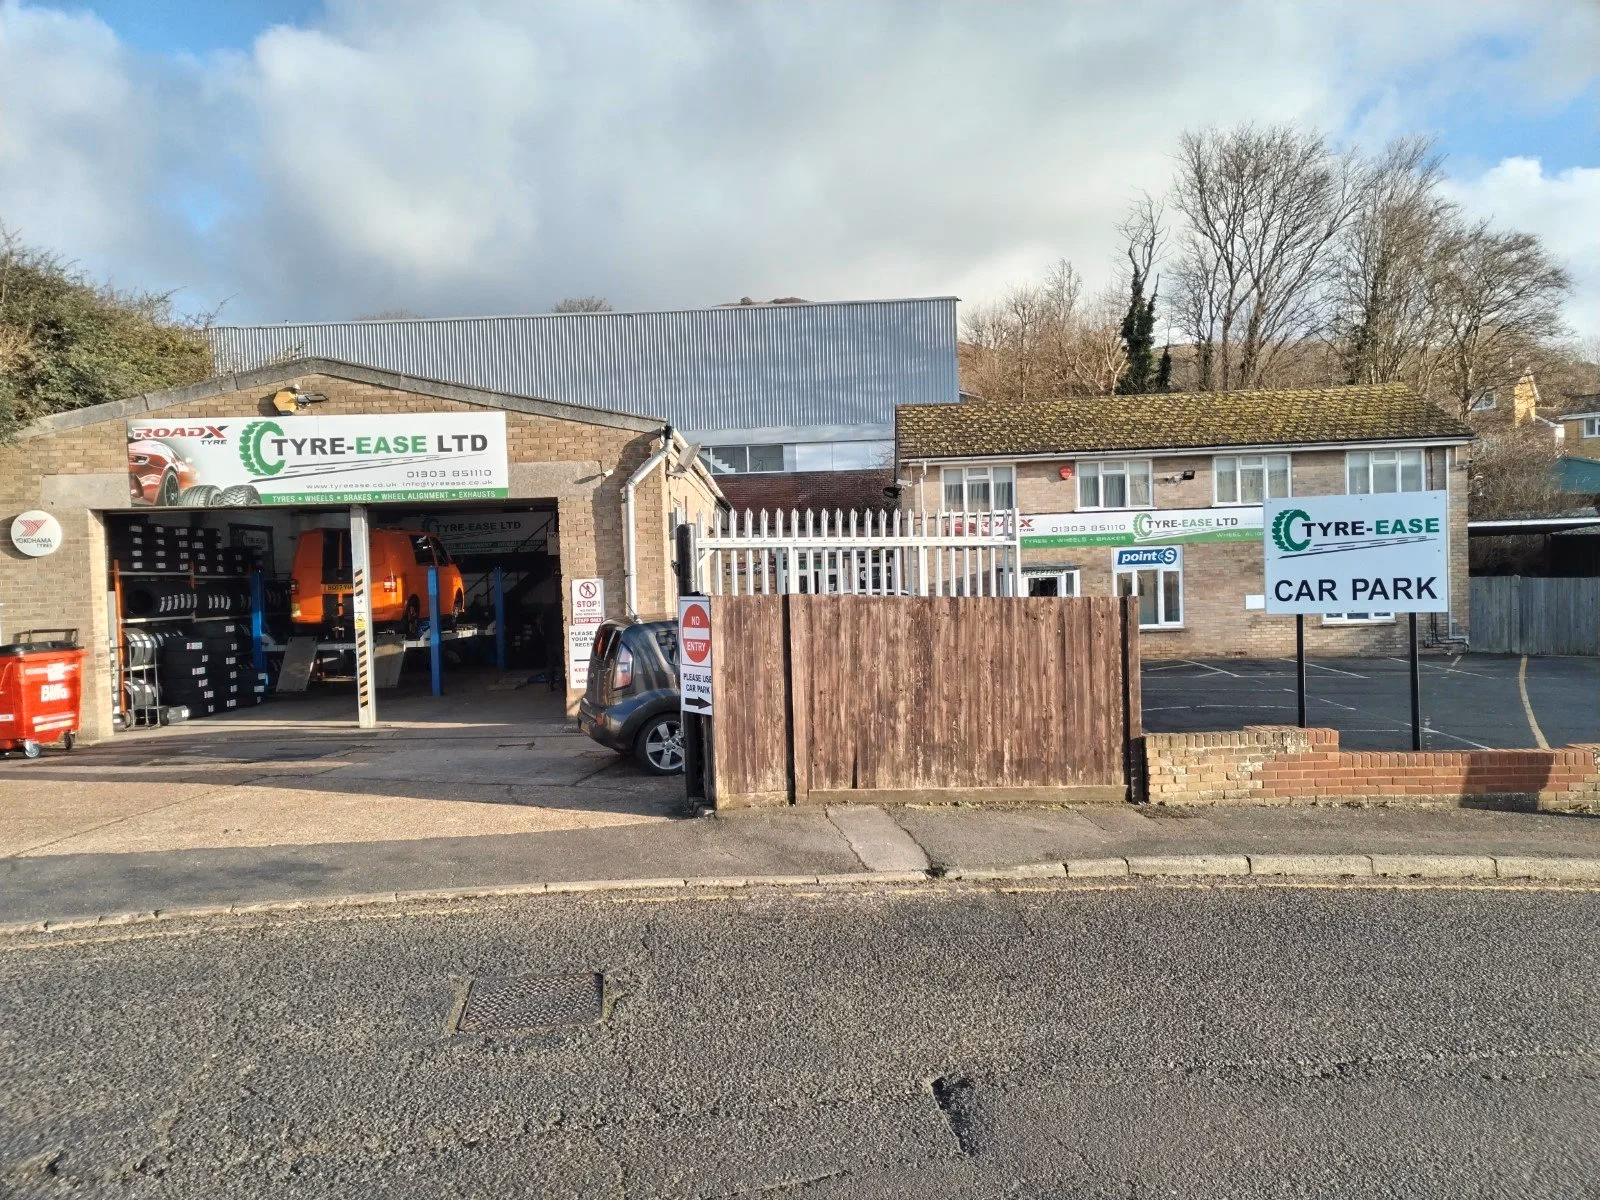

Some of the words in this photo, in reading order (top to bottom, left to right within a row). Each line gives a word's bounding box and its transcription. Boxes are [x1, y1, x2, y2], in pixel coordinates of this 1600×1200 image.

[134, 425, 230, 438] ROADX
[271, 435, 427, 456] TYRE-EASE
[438, 434, 488, 453] LTD
[406, 470, 446, 478] 01303
[452, 468, 492, 477] 851110
[272, 495, 295, 503] TYRES
[304, 494, 334, 502] WHEELS
[343, 493, 372, 501] BRAKES
[381, 492, 407, 500] WHEEL
[408, 491, 448, 499] ALIGNMENT
[459, 490, 496, 498] EXHAUSTS
[500, 520, 522, 530] LTD
[1052, 525, 1087, 533] 01303
[1091, 523, 1126, 531] 851110
[1147, 517, 1213, 530] TYRE-EASE
[1216, 517, 1239, 526] LTD
[1302, 518, 1440, 537] TYRE-EASE
[1122, 550, 1158, 563] point
[1164, 549, 1175, 562] S
[1275, 579, 1338, 601] CAR
[1352, 576, 1437, 600] PARK
[691, 616, 700, 626] NO
[686, 641, 706, 651] ENTRY
[683, 673, 701, 682] PLEASE
[702, 675, 712, 684] USE
[686, 684, 696, 692] CAR
[697, 685, 710, 694] PARK
